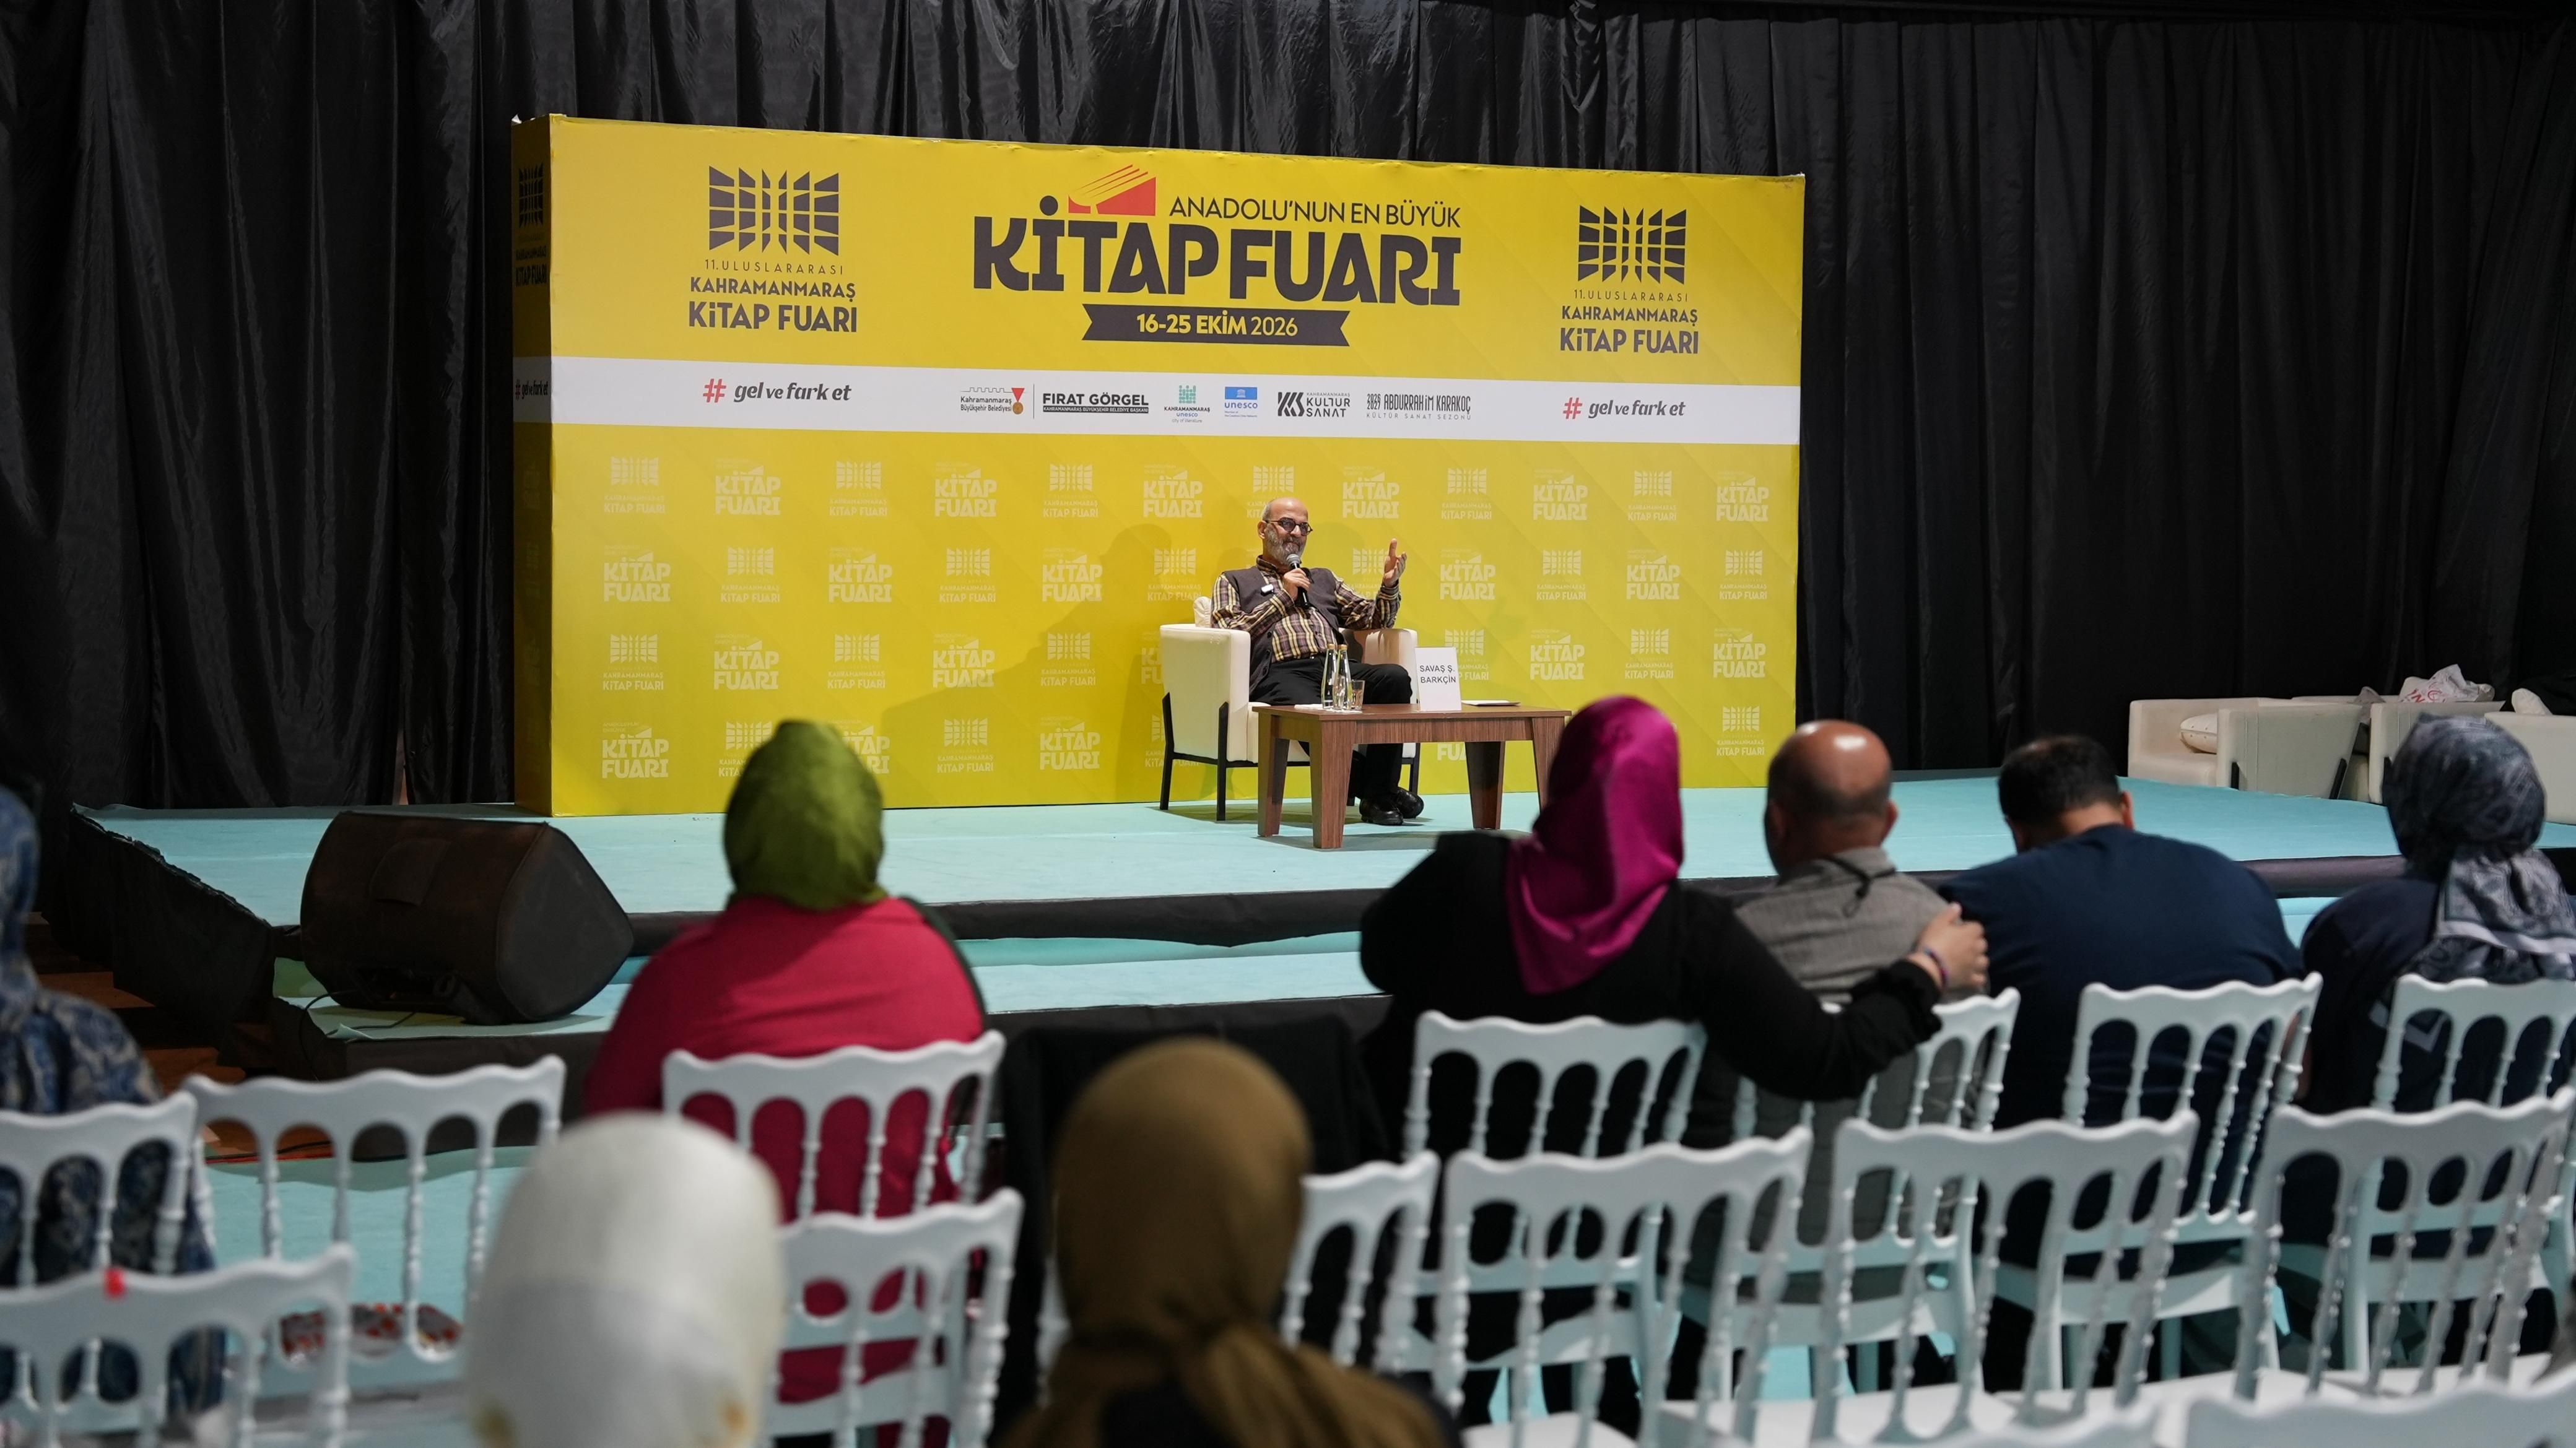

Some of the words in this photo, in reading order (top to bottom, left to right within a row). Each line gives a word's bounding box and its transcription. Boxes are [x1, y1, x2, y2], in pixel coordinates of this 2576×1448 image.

[1170, 197, 1344, 222] ANADOLU'NUN
[1351, 203, 1380, 223] EN
[1386, 200, 1460, 227] BÜYÜK
[973, 196, 1219, 294] KİTAP
[1230, 231, 1461, 306] FUARI
[691, 277, 855, 302] KAHRAMANMARAŞ
[779, 305, 856, 332] FUARI
[1137, 314, 1191, 333] 16-25
[1197, 310, 1247, 334] EKİM
[1251, 316, 1297, 336] 2026
[1562, 306, 1697, 326] KAHRAMANMARAŞ
[1634, 330, 1698, 353] FUARI
[734, 382, 764, 402] gel
[767, 388, 783, 399] ve
[786, 383, 829, 400] fark
[832, 385, 851, 401] et
[961, 396, 1011, 405] Kahramanmaraş
[1043, 393, 1084, 404] FIRAT
[1089, 392, 1149, 405] GÖRGEL
[1307, 408, 1346, 417] SANAT
[1437, 396, 1471, 414] KARAKOÇ
[1588, 400, 1613, 418] gel
[1615, 405, 1629, 415] ve
[1632, 401, 1667, 415] fark
[1669, 402, 1686, 415] et
[716, 470, 781, 495] KİTAP
[935, 474, 997, 498] KİTAP
[1144, 475, 1203, 498] KİTAP
[1343, 476, 1399, 500] KİTAP
[1533, 479, 1588, 502] KİTAP
[1717, 480, 1769, 503] KİTAP
[716, 496, 780, 515] FUARI
[935, 499, 996, 517] FUARI
[1144, 500, 1202, 518] FUARI
[1342, 501, 1399, 519] FUARI
[1533, 503, 1587, 521] FUARI
[1717, 505, 1769, 522] FUARI
[604, 557, 671, 582] KİTAP
[829, 559, 892, 583] KİTAP
[1042, 559, 1103, 583] KİTAP
[1440, 559, 1495, 582] KİTAP
[1627, 560, 1680, 582] KİTAP
[604, 583, 670, 602] FUARI
[829, 584, 892, 602] FUARI
[1042, 584, 1102, 602] FUARI
[1440, 583, 1495, 600] FUARI
[1627, 583, 1679, 600] FUARI
[715, 646, 778, 670] KİTAP
[933, 644, 994, 669] KİTAP
[1531, 639, 1585, 662] KİTAP
[1714, 638, 1765, 661] KİTAP
[933, 669, 994, 688] FUARI
[1420, 665, 1445, 673] SAVAŞ
[1448, 665, 1455, 673] Ş.
[1530, 663, 1584, 680] FUARI
[1713, 661, 1765, 678] FUARI
[714, 671, 778, 690] FUARI
[1421, 675, 1456, 685] BARKÇİN
[603, 734, 669, 758] KİTAP
[1040, 727, 1100, 751] KİTAP
[602, 760, 668, 778] FUARI
[1040, 752, 1099, 770] FUARI
